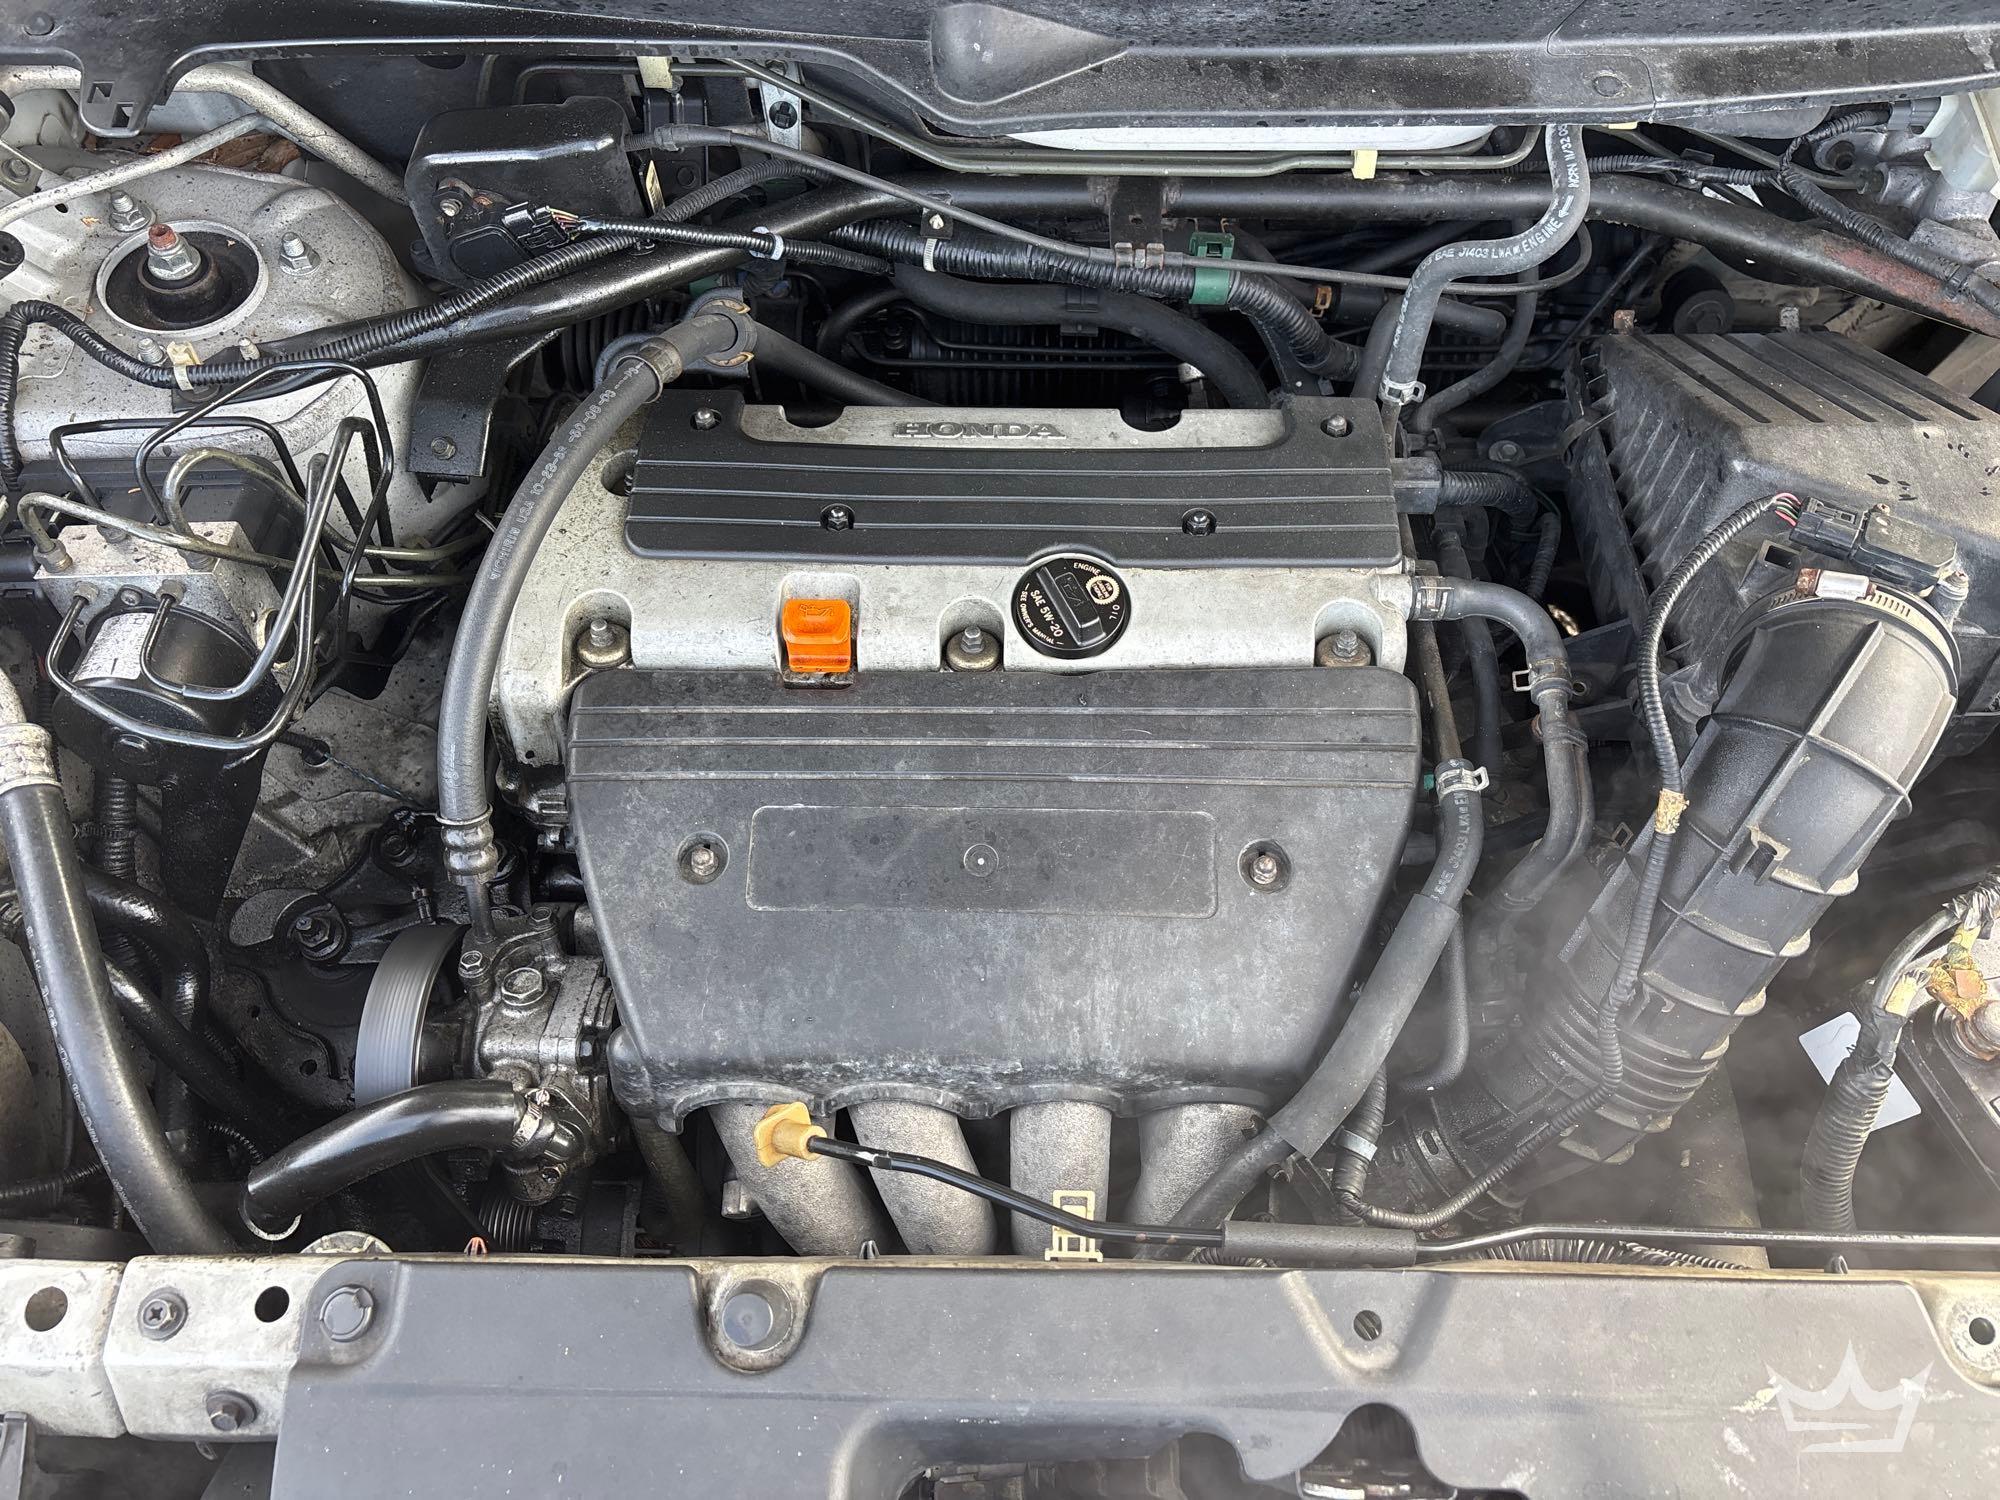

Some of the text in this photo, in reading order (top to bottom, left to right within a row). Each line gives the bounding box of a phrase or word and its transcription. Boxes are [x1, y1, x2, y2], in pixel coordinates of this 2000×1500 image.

[1521, 217, 1564, 252] ENGINE
[892, 421, 1067, 439] HONDA
[516, 499, 536, 524] USA
[1073, 562, 1121, 620] ENGINE OIL
[1020, 590, 1028, 602] SEE
[1031, 626, 1055, 645] MANUAL
[1030, 589, 1064, 638] SAE 5W-20
